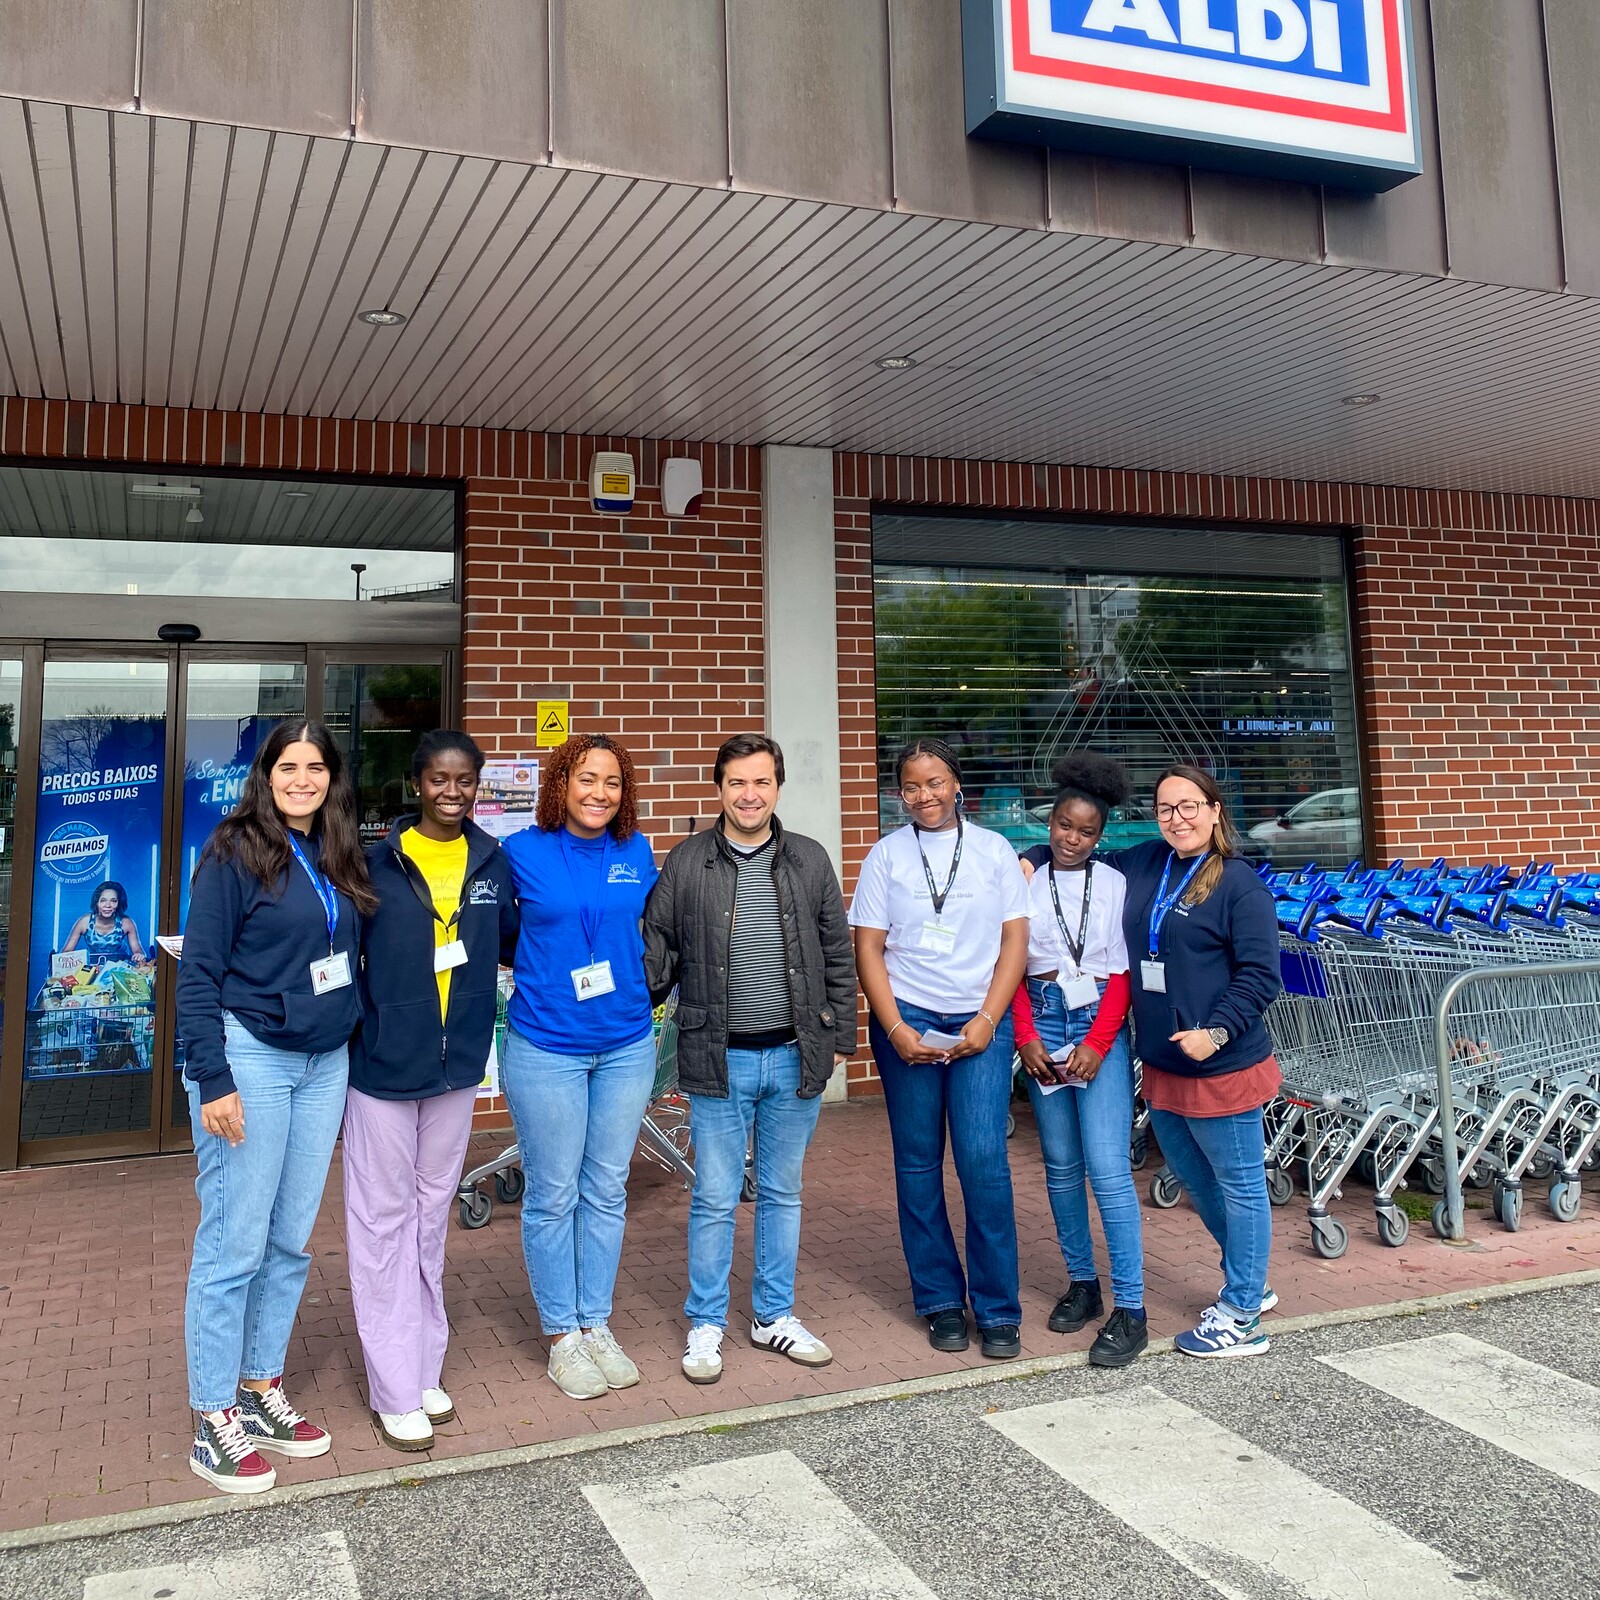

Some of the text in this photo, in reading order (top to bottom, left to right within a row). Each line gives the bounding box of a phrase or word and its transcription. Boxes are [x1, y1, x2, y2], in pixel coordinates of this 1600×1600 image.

[42, 764, 158, 792] PREÇOS BAIXOS
[62, 787, 139, 806] TODOS OS DIAS
[67, 824, 95, 836] MARCAS
[359, 822, 385, 830] ALDI
[44, 839, 105, 857] CONFIAMOS
[66, 863, 83, 871] ALDI
